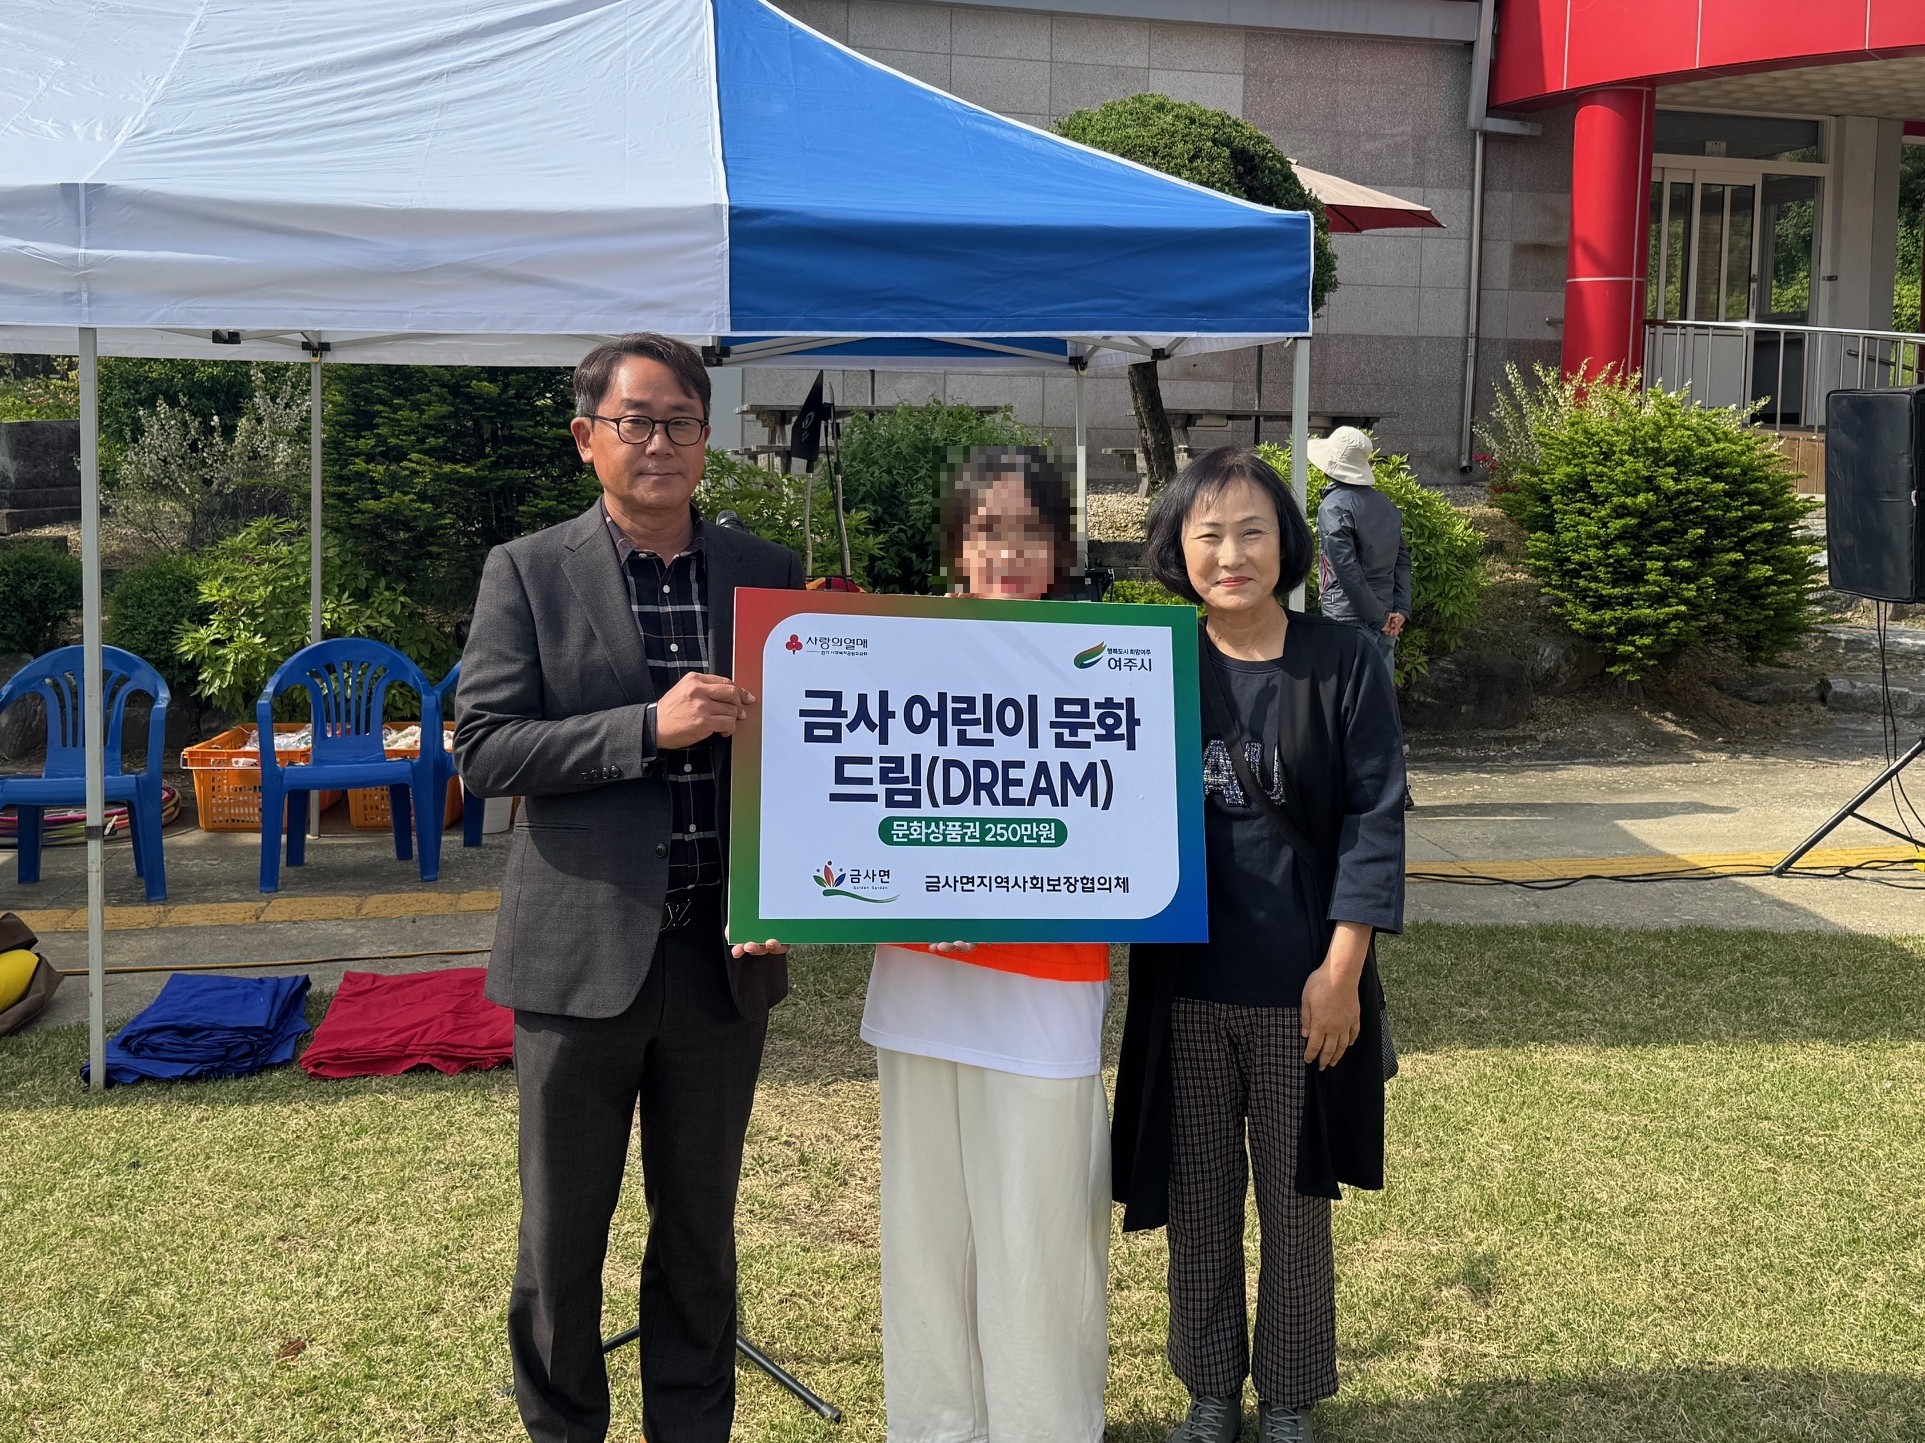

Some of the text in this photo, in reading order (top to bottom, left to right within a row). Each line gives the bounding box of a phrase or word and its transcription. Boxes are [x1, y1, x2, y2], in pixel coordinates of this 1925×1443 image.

[806, 636, 868, 650] 사랑의열매
[1107, 657, 1153, 672] 여주시
[798, 689, 1141, 751] 금사 어린이 문화
[828, 753, 1114, 811] 드림(DREAM)
[891, 821, 1056, 843] 문화상품권 250만원
[849, 869, 891, 884] 금사면
[924, 874, 1130, 894] 금사면지역사회보장협의체
